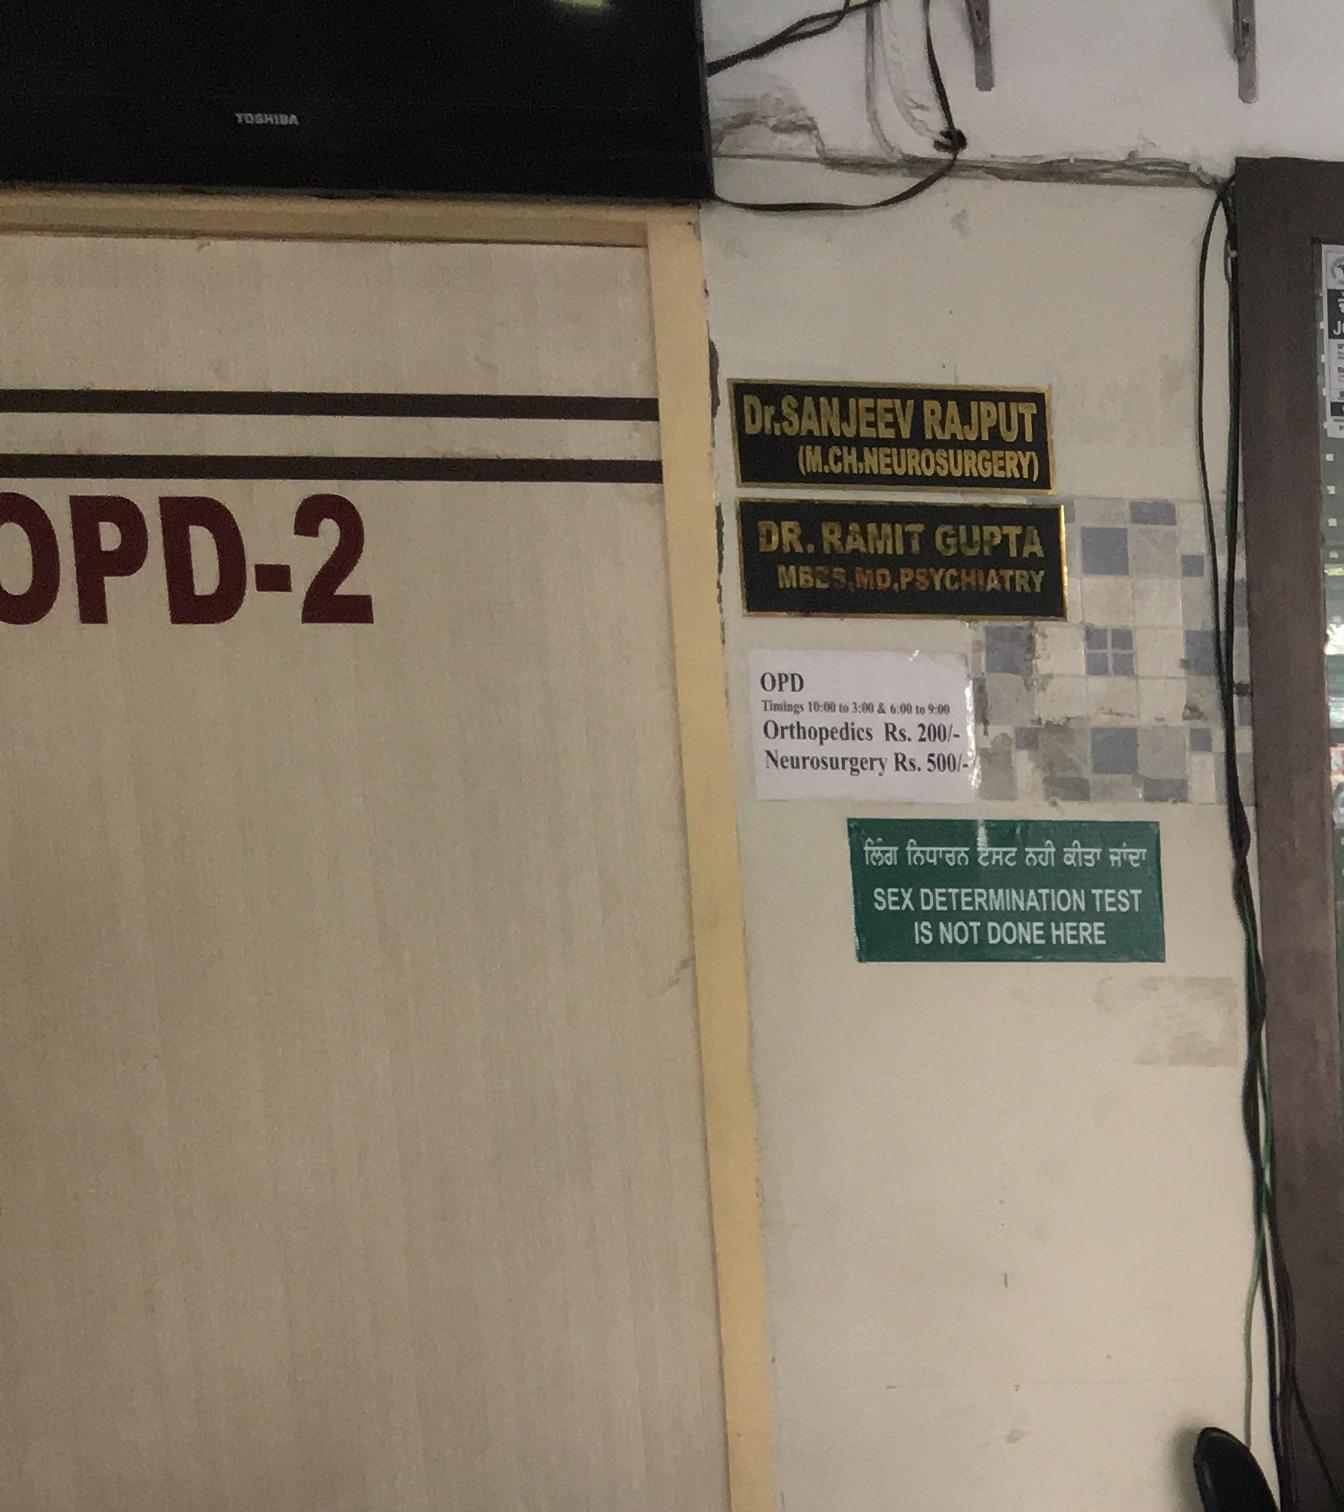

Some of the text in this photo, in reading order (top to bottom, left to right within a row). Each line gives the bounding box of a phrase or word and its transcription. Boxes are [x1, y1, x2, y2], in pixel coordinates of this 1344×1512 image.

[235, 112, 299, 126] TOSHIBA
[923, 399, 1038, 443] RAJPUT
[757, 520, 1045, 559] DR. RAMIT GUPTA
[0, 491, 374, 625] OPD-2
[760, 672, 804, 693] OPD
[762, 700, 950, 715] Timings 10:00 to 3:00 & 6:00 to 9:00
[763, 719, 960, 746] Orthopedics Rs. 200/-
[765, 750, 969, 776] Neurosurgery Rs. 500/-
[1063, 839, 1103, 867] ਕੀਤਾ
[1108, 841, 1148, 867] ਜਾਂਦਾ
[873, 887, 1143, 912] SEX DETERMINATION TEST
[914, 921, 1107, 945] IS NOT DONE HERE
